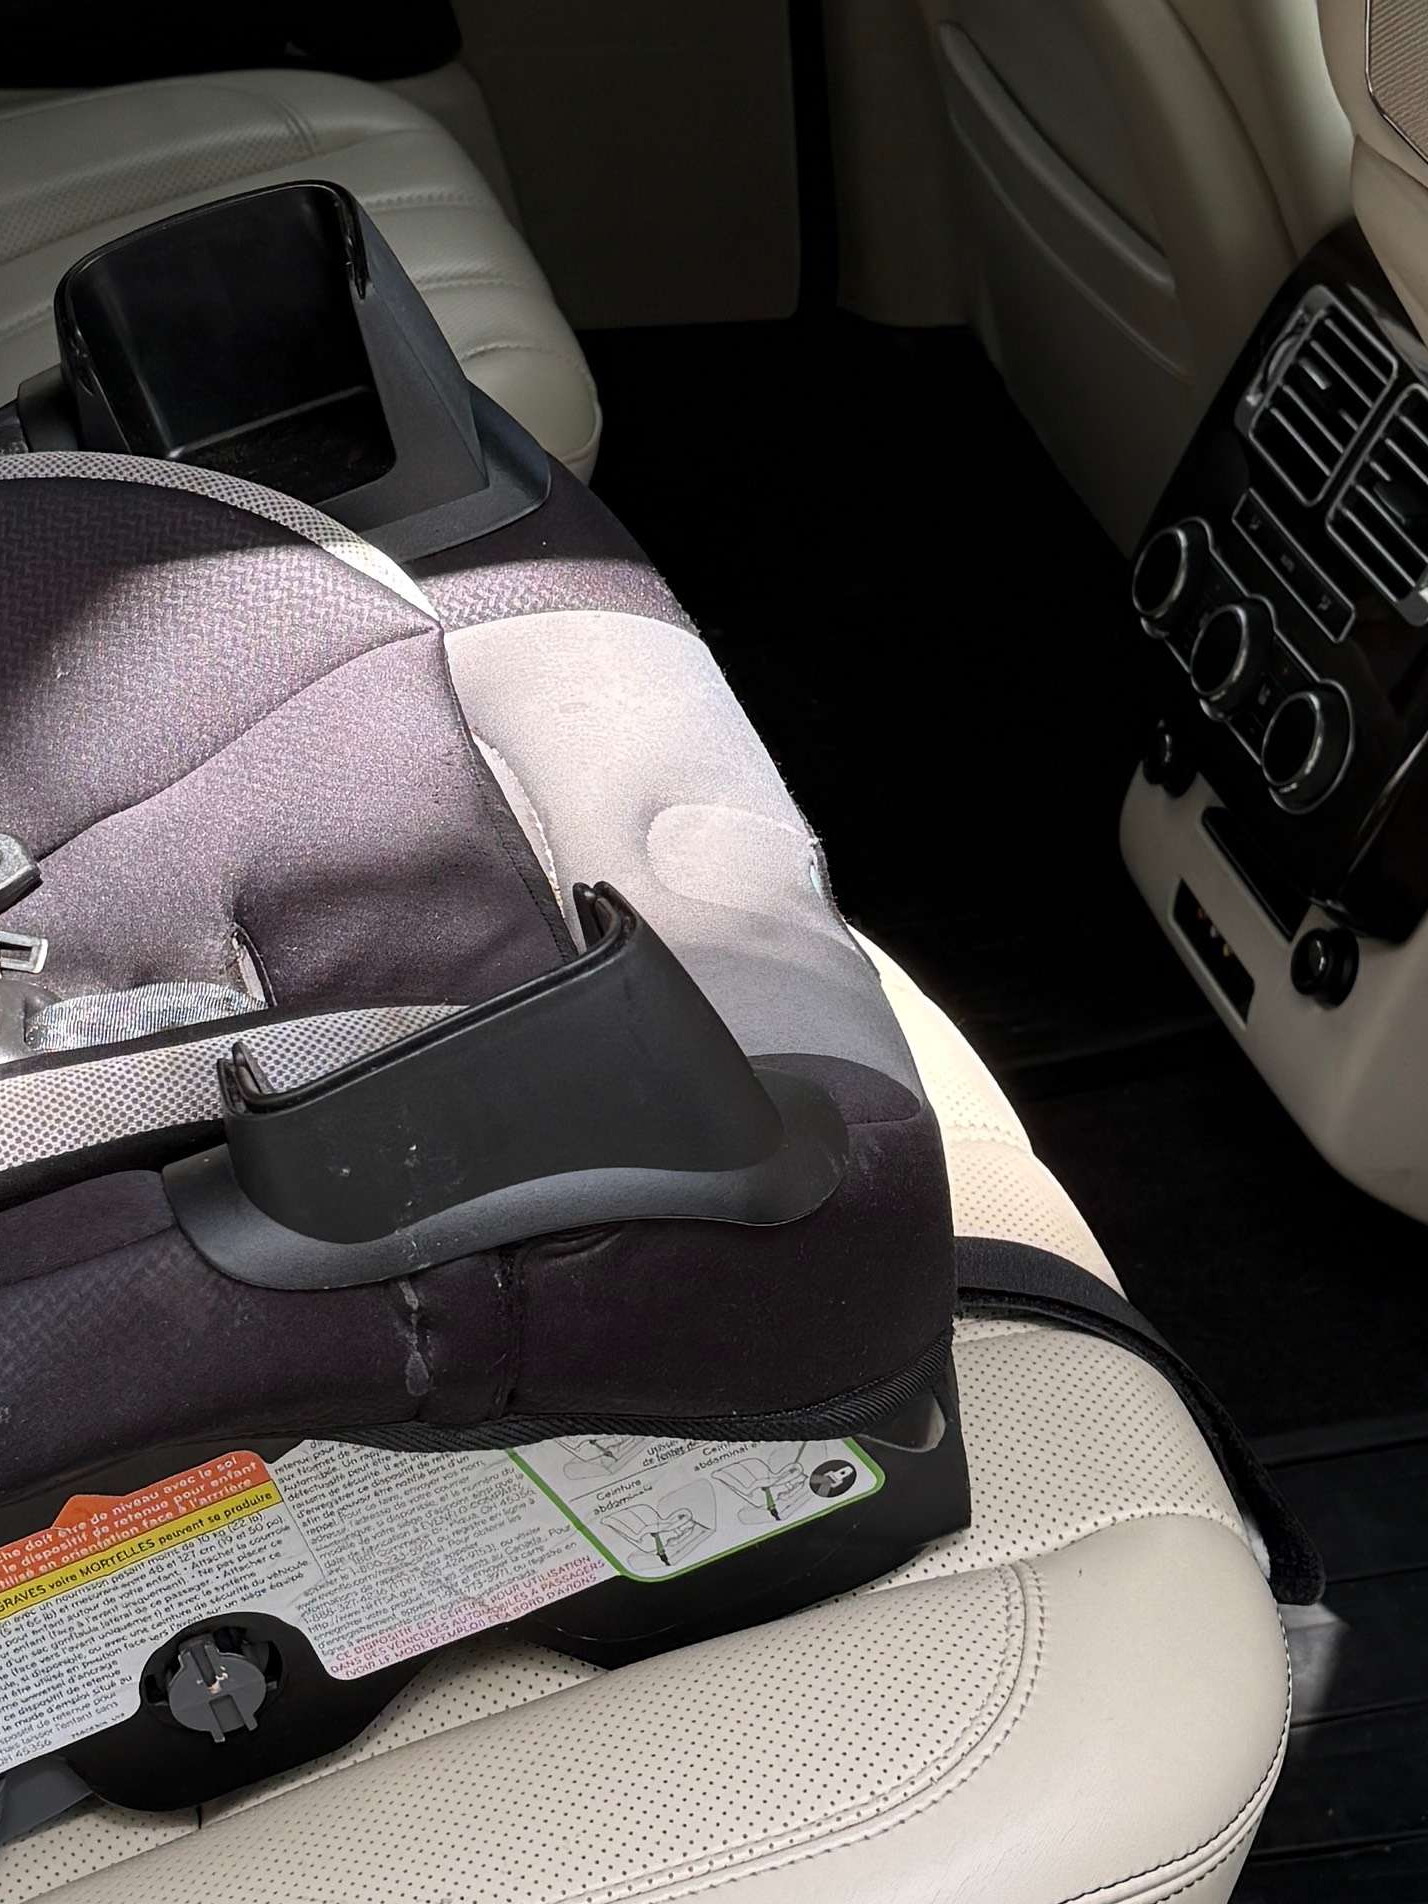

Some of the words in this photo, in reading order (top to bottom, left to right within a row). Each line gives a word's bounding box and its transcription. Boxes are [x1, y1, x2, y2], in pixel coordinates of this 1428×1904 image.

[596, 1479, 640, 1500] Ceinture
[694, 1444, 747, 1471] abdominal
[2, 1564, 16, 1573] le
[21, 1532, 86, 1565] dispositif
[92, 1526, 108, 1537] de
[114, 1501, 167, 1527] retenue
[173, 1484, 204, 1506] pour
[210, 1462, 255, 1486] enfant
[25, 1533, 51, 1550] doit
[90, 1513, 106, 1524] de
[112, 1492, 158, 1515] niveau
[163, 1476, 195, 1493] avec
[198, 1469, 211, 1478] le
[217, 1456, 236, 1471] sol
[48, 1574, 76, 1588] voire
[79, 1538, 154, 1576] MORTELLES
[158, 1518, 203, 1545] peuvent
[207, 1514, 220, 1522] se
[223, 1493, 271, 1518] produire
[39, 1561, 56, 1572] en
[61, 1526, 138, 1563] orientation
[142, 1512, 172, 1528] face
